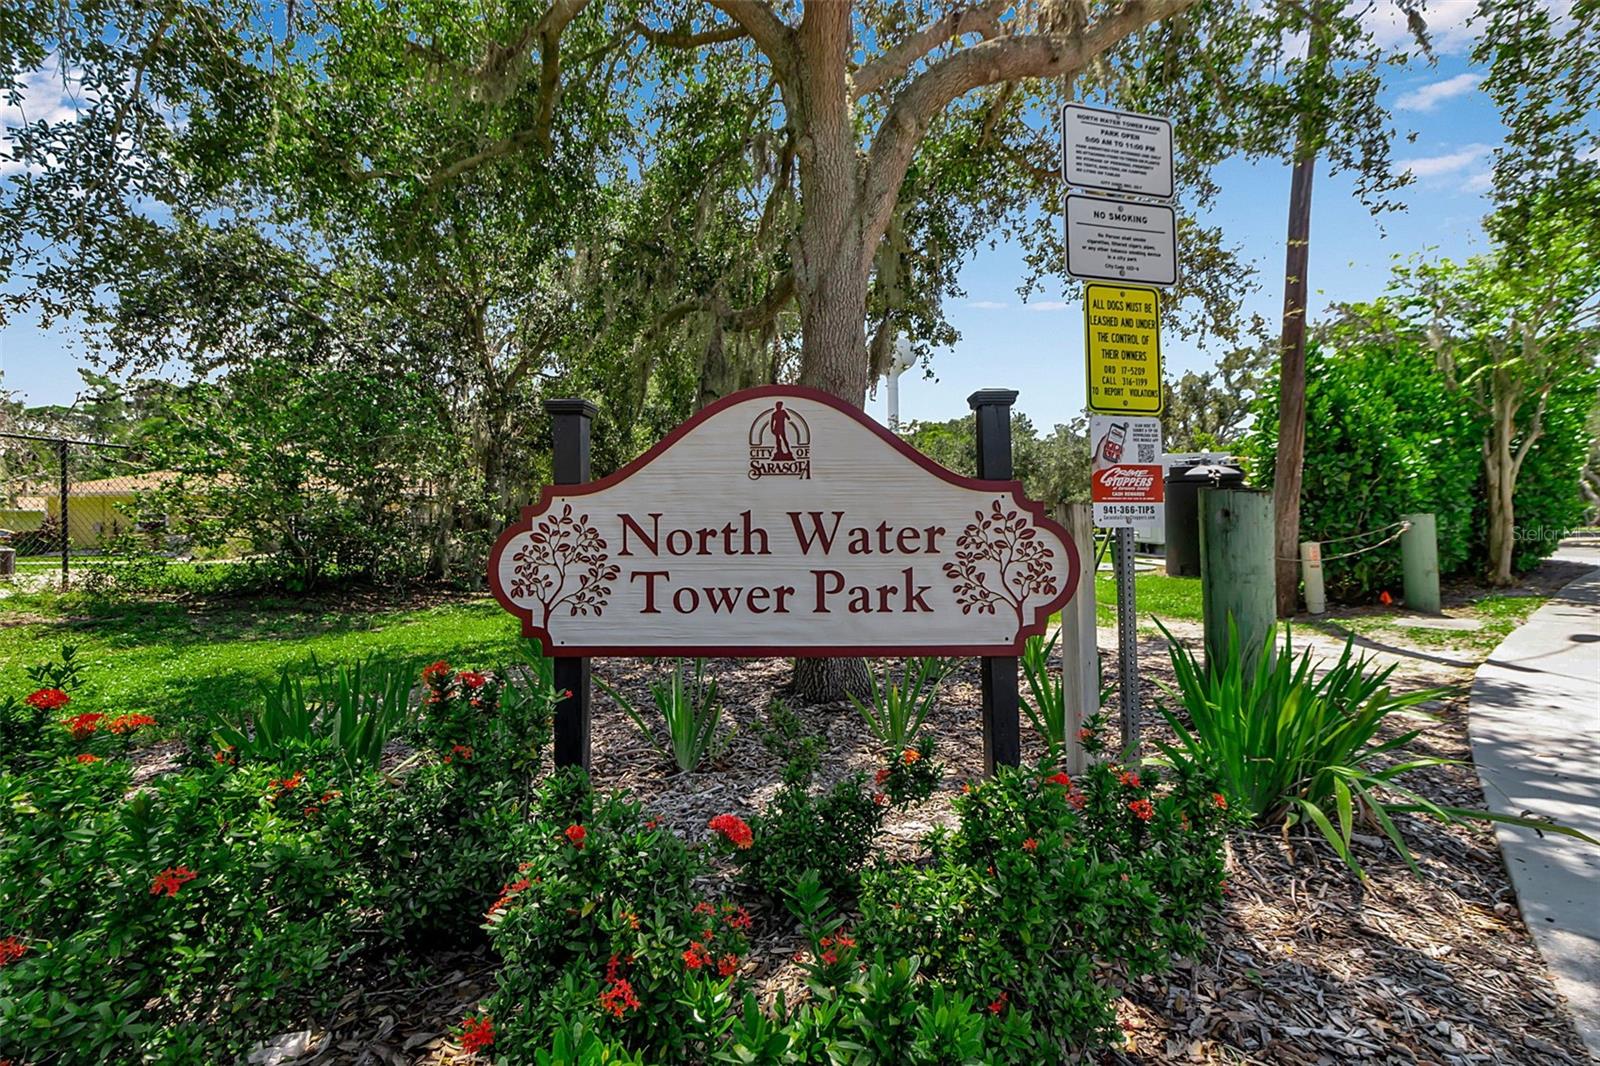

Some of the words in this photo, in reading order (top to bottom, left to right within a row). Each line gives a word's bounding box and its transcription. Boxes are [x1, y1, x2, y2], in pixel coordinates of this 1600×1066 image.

[1125, 142, 1144, 150] 11:00
[1093, 210, 1105, 219] NO
[1109, 213, 1148, 224] SMOKING
[1092, 299, 1104, 310] ALL
[1107, 300, 1124, 311] DOGS
[1126, 302, 1142, 312] MUST
[1144, 304, 1152, 313] BE
[1090, 315, 1118, 326] LEASHED
[1121, 318, 1133, 328] AND
[1136, 319, 1156, 329] UNDER
[1097, 332, 1109, 342] THE
[1111, 333, 1139, 345] CONTROL
[1142, 335, 1150, 345] OF
[1101, 349, 1120, 360] THEIR
[1121, 351, 1147, 361] OWNERS
[1121, 367, 1145, 375] 17-5209
[1102, 376, 1116, 385] CALL
[1122, 378, 1148, 386] 316-1199
[1104, 388, 1123, 396] REPORT
[1130, 389, 1158, 398] VIOLATIONS
[750, 448, 773, 457] CITY
[796, 448, 810, 457] OF
[748, 460, 811, 480] SARASOTA
[1100, 467, 1148, 483] CRIME
[1105, 477, 1154, 487] STOPPERS
[1103, 506, 1155, 514] 941-366-TIPS
[616, 509, 772, 556] North
[786, 511, 946, 556] Water
[630, 570, 796, 614] Tower
[809, 566, 934, 614] Park
